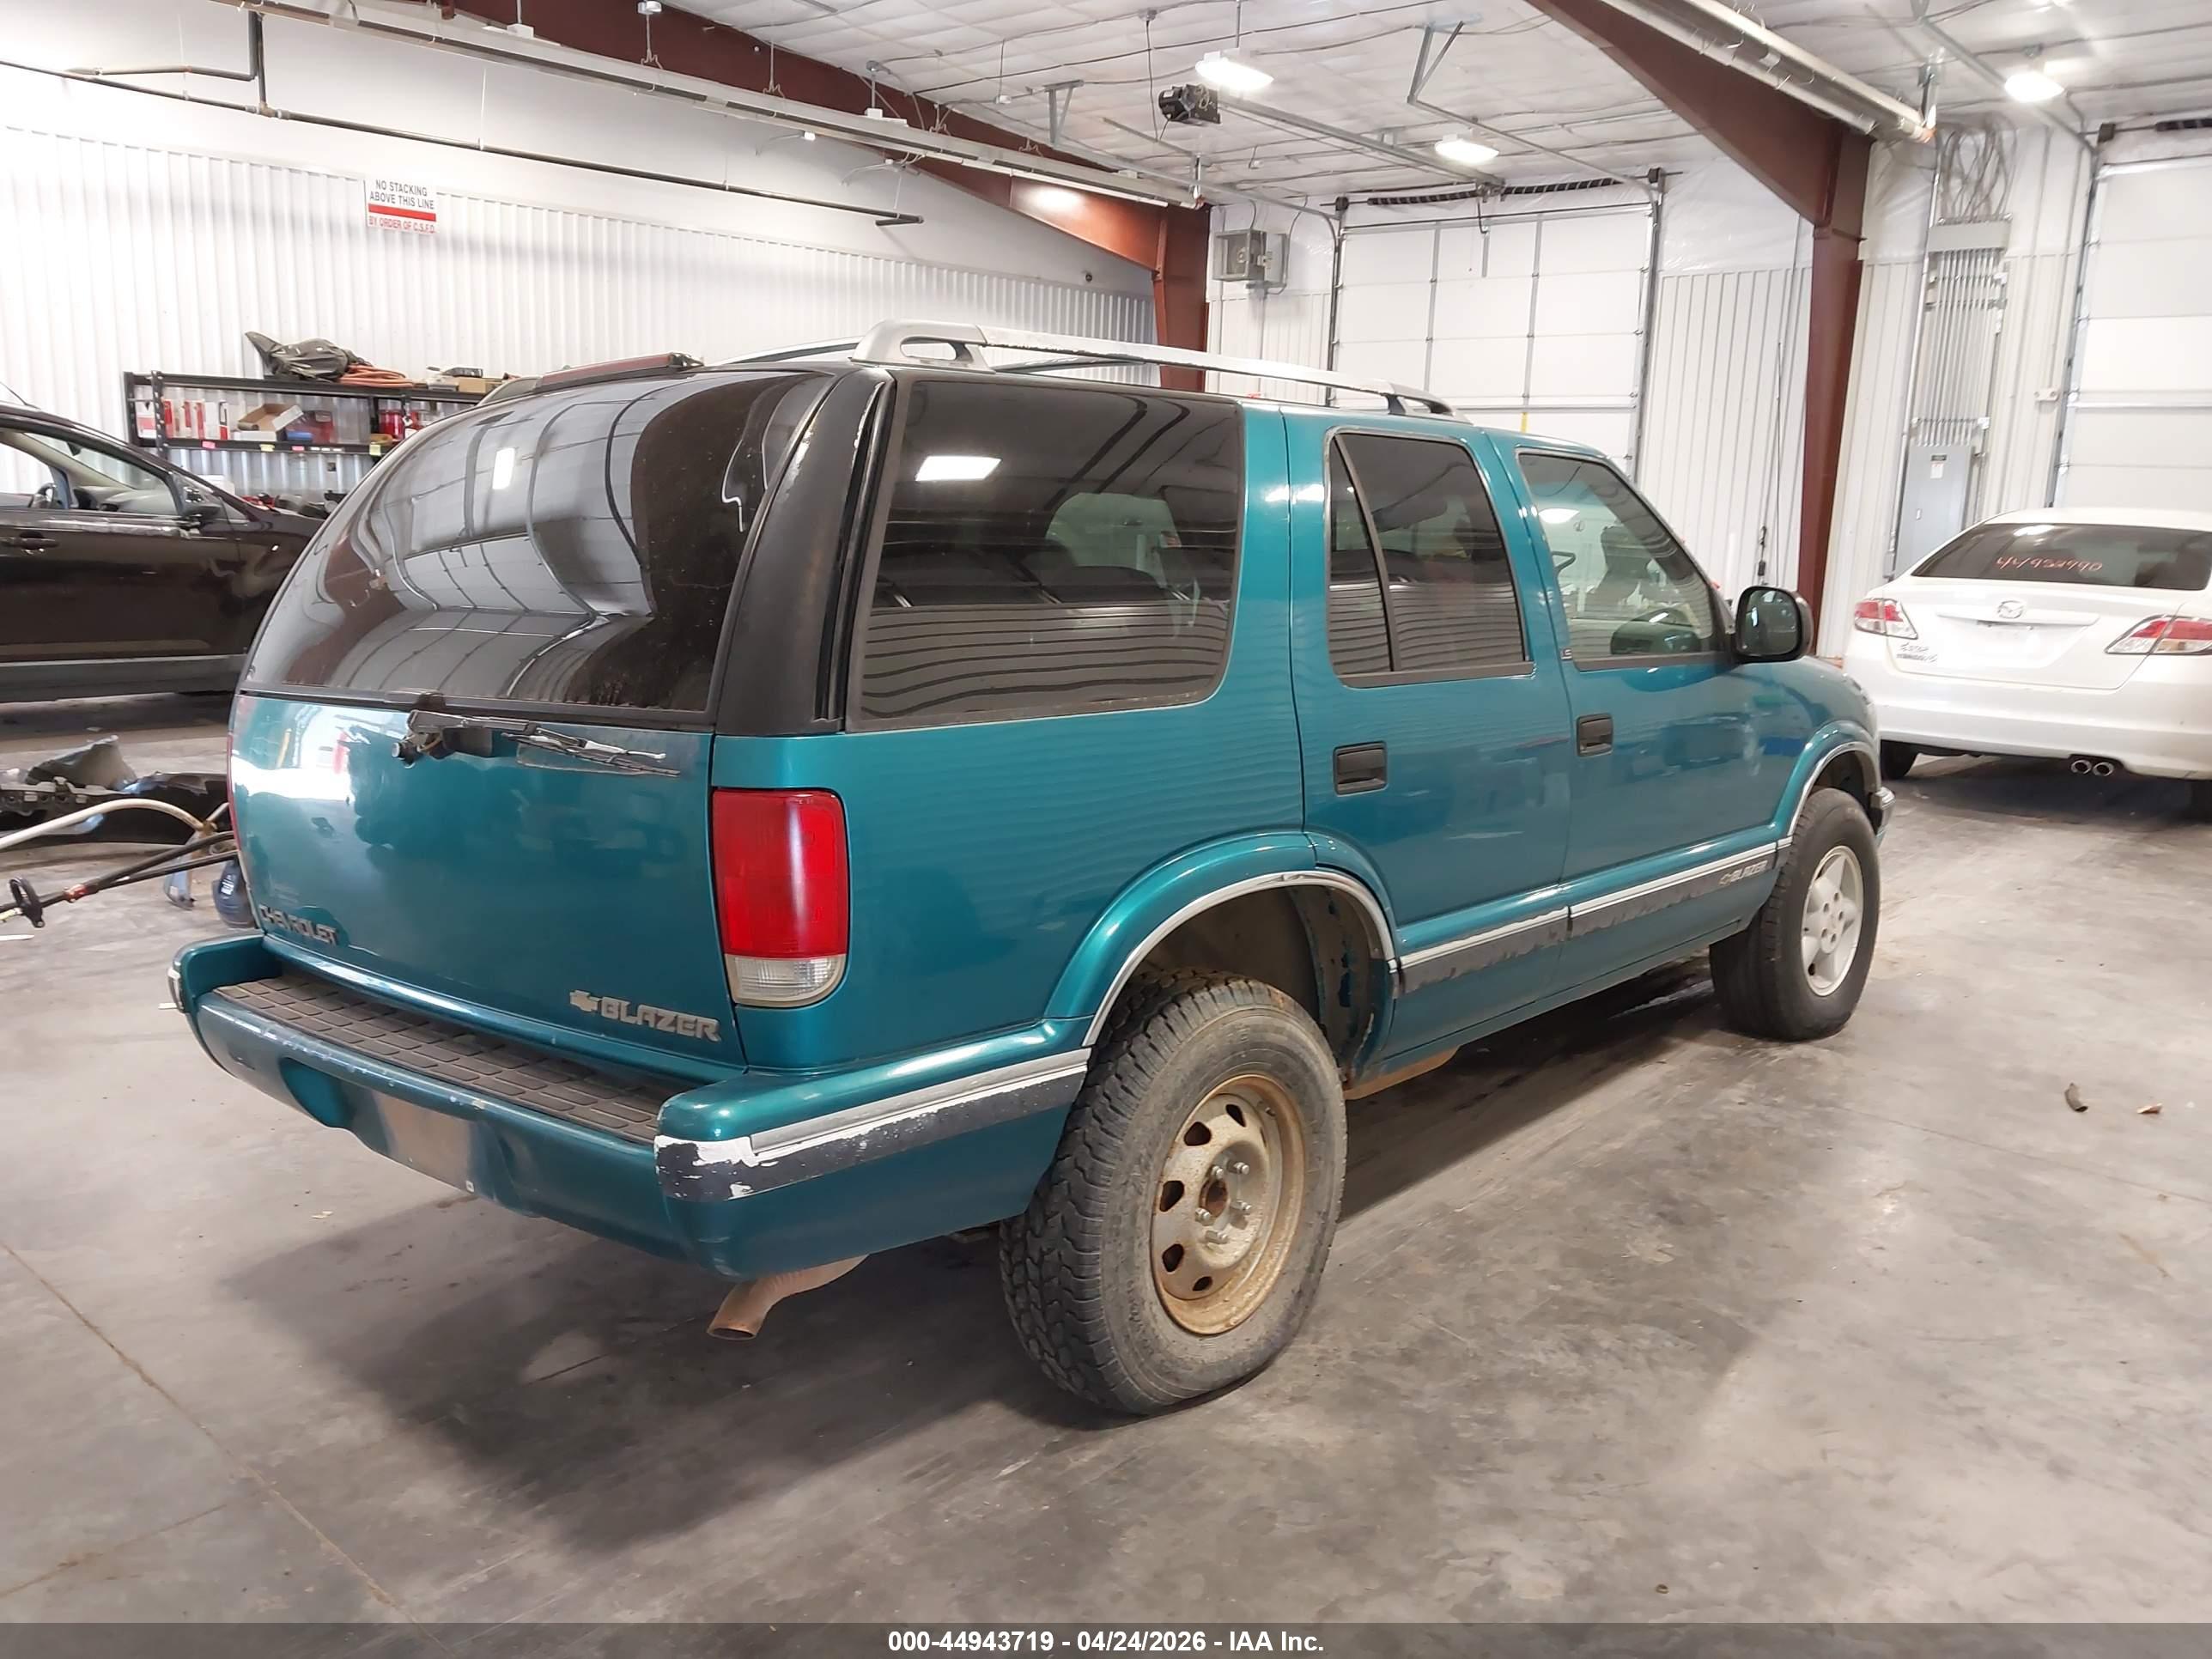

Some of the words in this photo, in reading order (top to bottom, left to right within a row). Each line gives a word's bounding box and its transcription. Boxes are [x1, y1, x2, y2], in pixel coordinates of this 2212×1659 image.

[375, 179, 386, 191] NO
[389, 181, 428, 197] STACKING
[370, 191, 396, 204] ABOVE
[398, 195, 416, 207] THIS
[417, 198, 435, 210] LINE
[380, 217, 402, 229] ORDER
[403, 221, 411, 230] OF
[258, 904, 337, 946] CHEVROLET
[600, 996, 722, 1042] BLAZER
